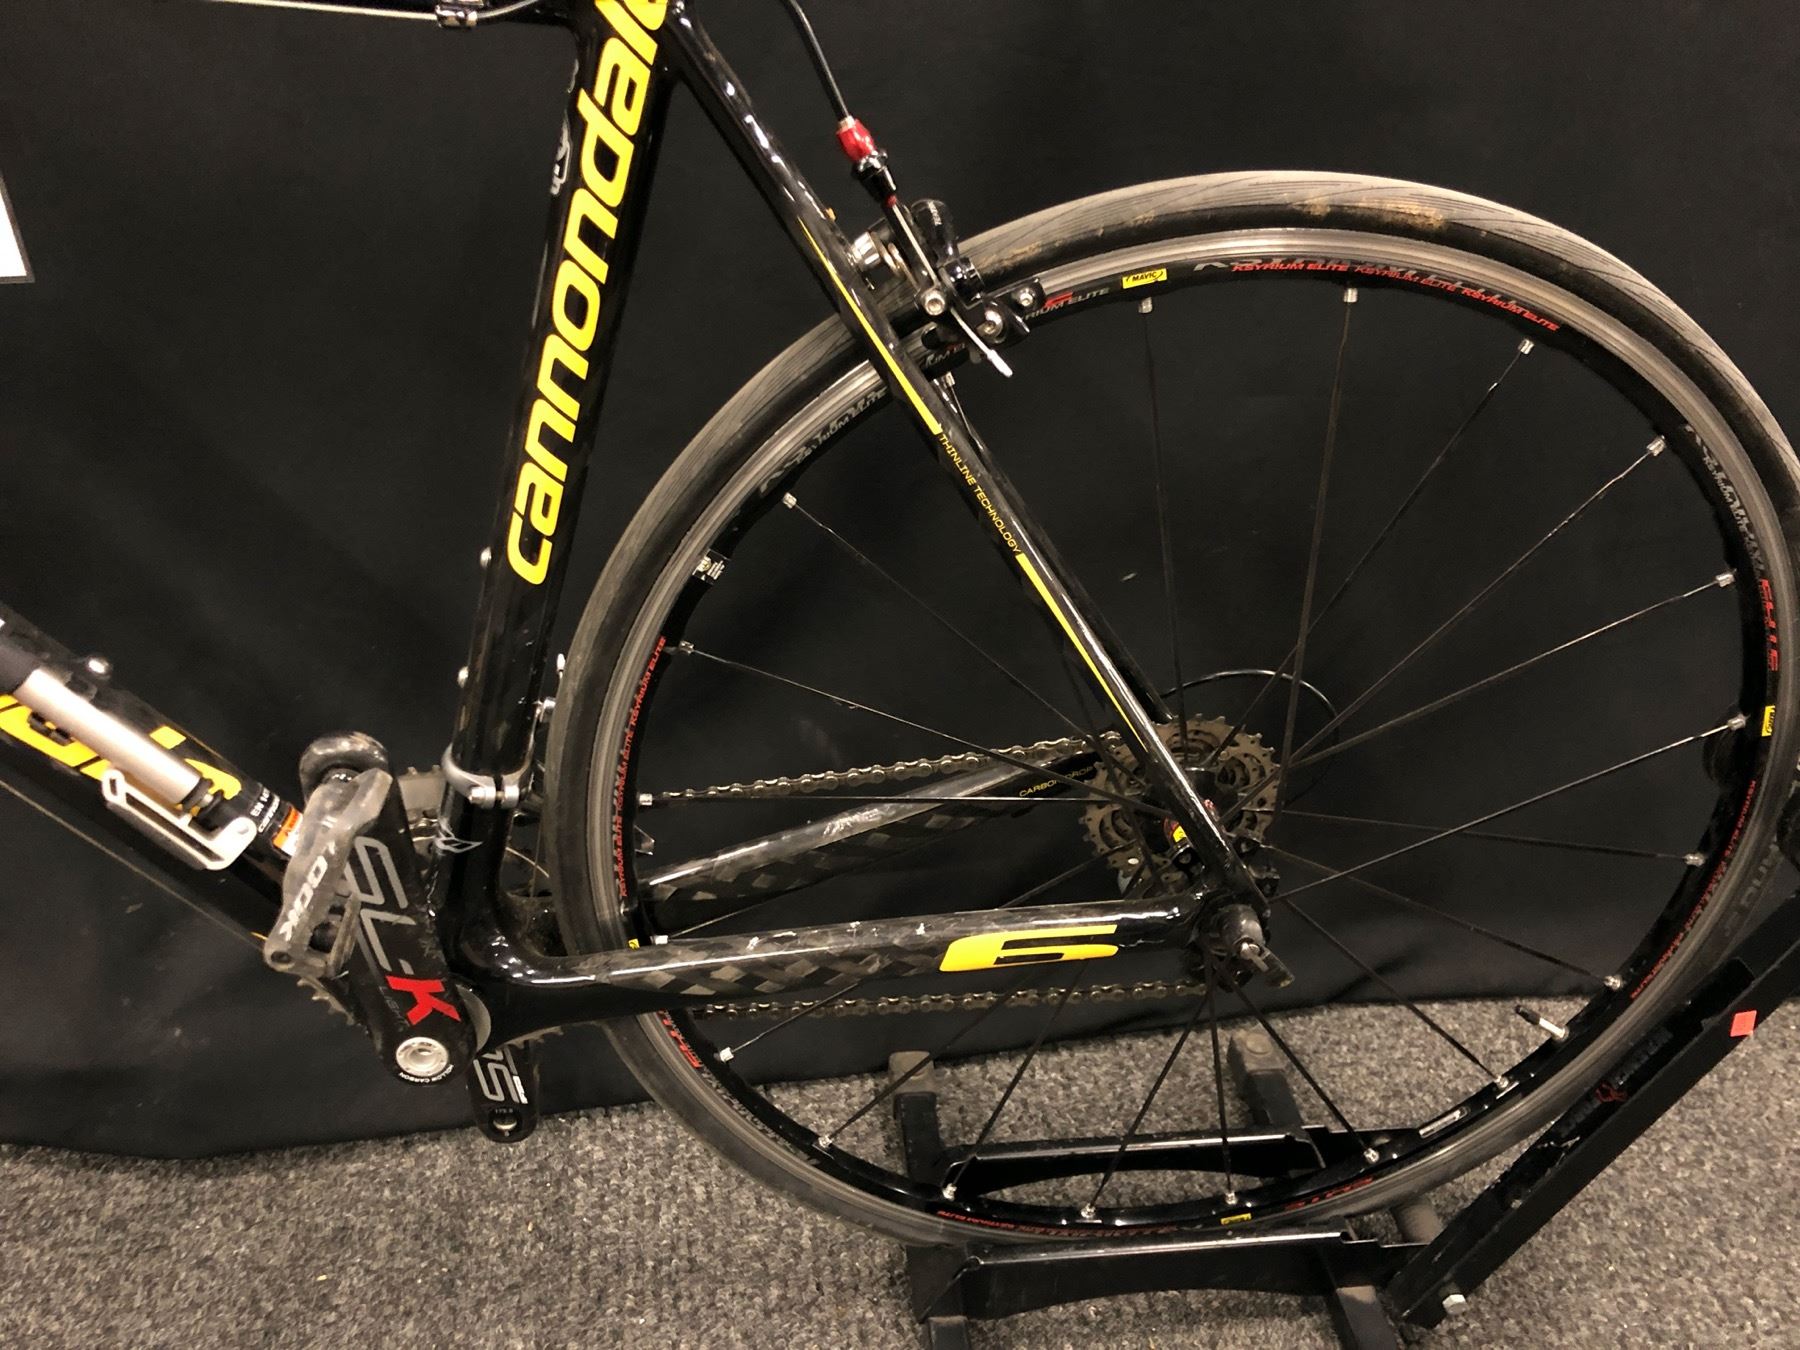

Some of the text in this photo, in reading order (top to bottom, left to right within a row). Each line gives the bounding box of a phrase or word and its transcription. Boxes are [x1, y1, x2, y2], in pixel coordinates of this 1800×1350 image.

[1307, 263, 1350, 272] ELITE
[1132, 271, 1158, 283] MAVIC
[1069, 288, 1110, 303] ELITE
[940, 434, 1021, 552] THINLINE TECHNOLOGY
[1019, 780, 1057, 797] CARBO
[279, 840, 336, 942] LOOK
[344, 836, 461, 1025] SL-K
